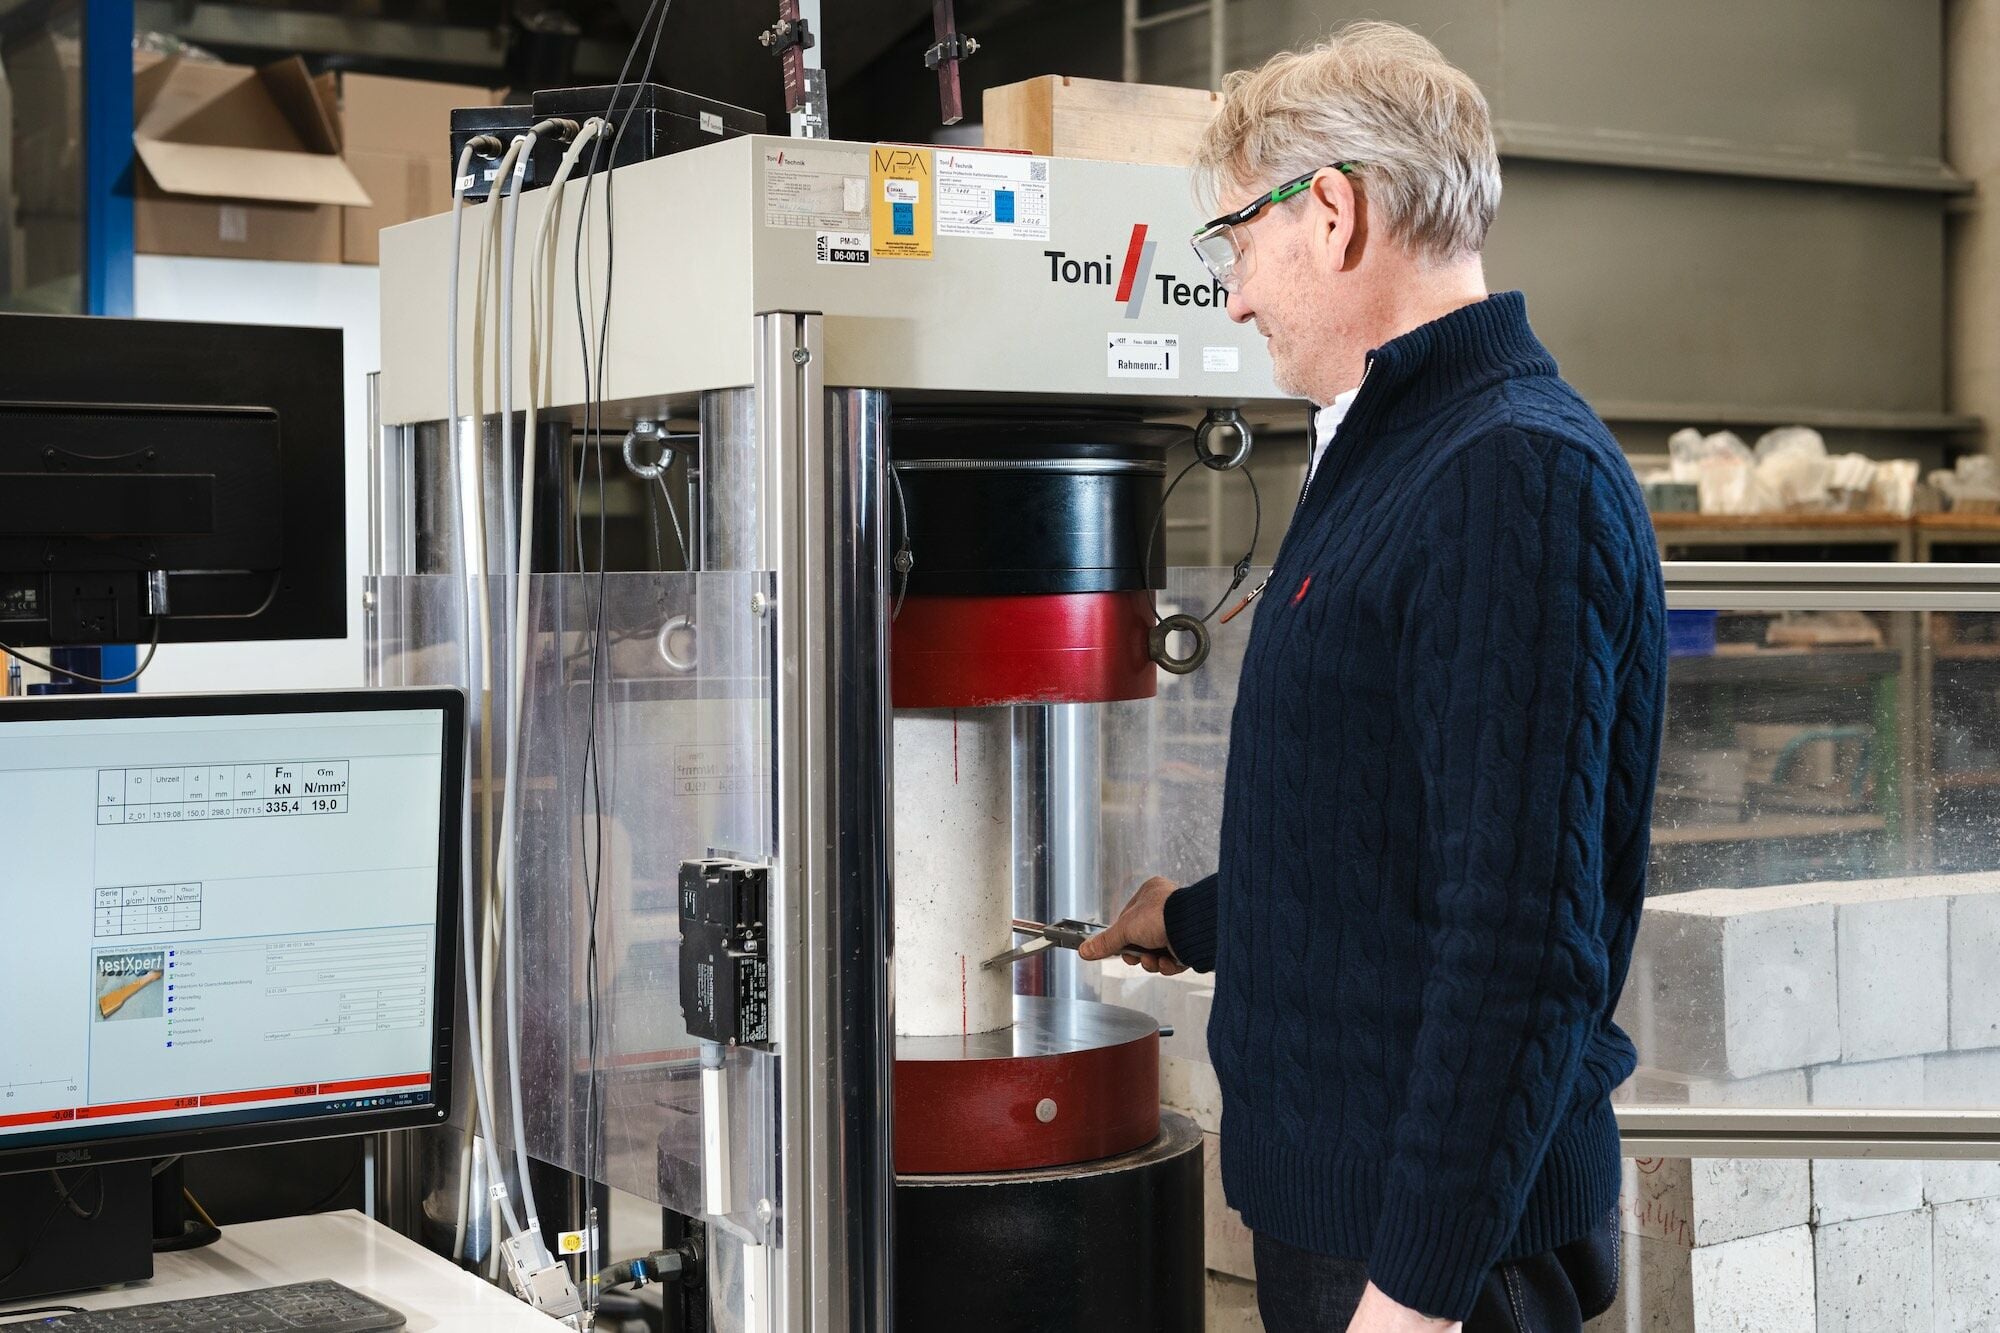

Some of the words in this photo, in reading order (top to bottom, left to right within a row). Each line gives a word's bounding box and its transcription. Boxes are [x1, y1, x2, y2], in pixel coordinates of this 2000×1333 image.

[876, 150, 927, 174] MPA
[840, 237, 861, 246] PM-ID:
[834, 251, 866, 261] 06-0015
[1044, 250, 1112, 284] Toni
[1155, 274, 1228, 308] Tech
[1118, 360, 1162, 370] Rahmennr.:
[275, 767, 292, 778] Fm
[274, 784, 291, 795] kN
[305, 781, 346, 793] N/mm²
[236, 807, 261, 815] 17671,5
[266, 801, 299, 813] 335,4
[312, 799, 337, 811] 19,0
[99, 955, 162, 974] testXpert
[56, 1149, 91, 1163] DELL
